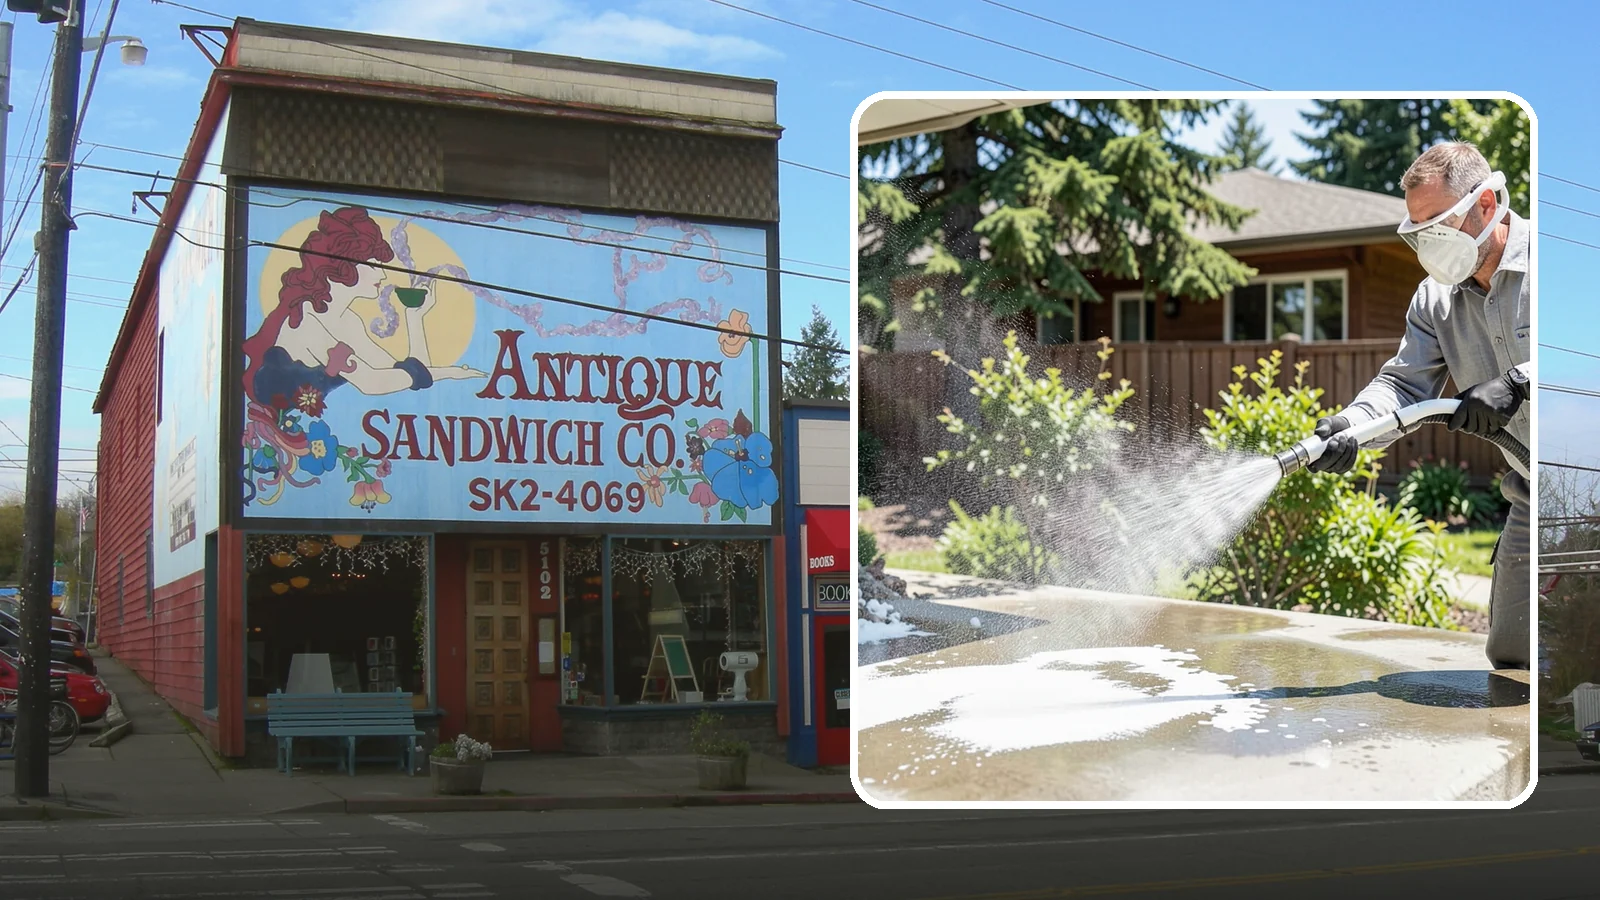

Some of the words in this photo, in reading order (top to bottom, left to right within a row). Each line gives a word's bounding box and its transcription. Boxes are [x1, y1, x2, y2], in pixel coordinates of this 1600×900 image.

[476, 329, 723, 421] ANTIQUE
[362, 409, 604, 467] SANDWICH
[617, 422, 684, 468] CO.
[469, 477, 645, 513] SK2-4069
[540, 542, 551, 599] 5102
[809, 555, 835, 569] BOOKS
